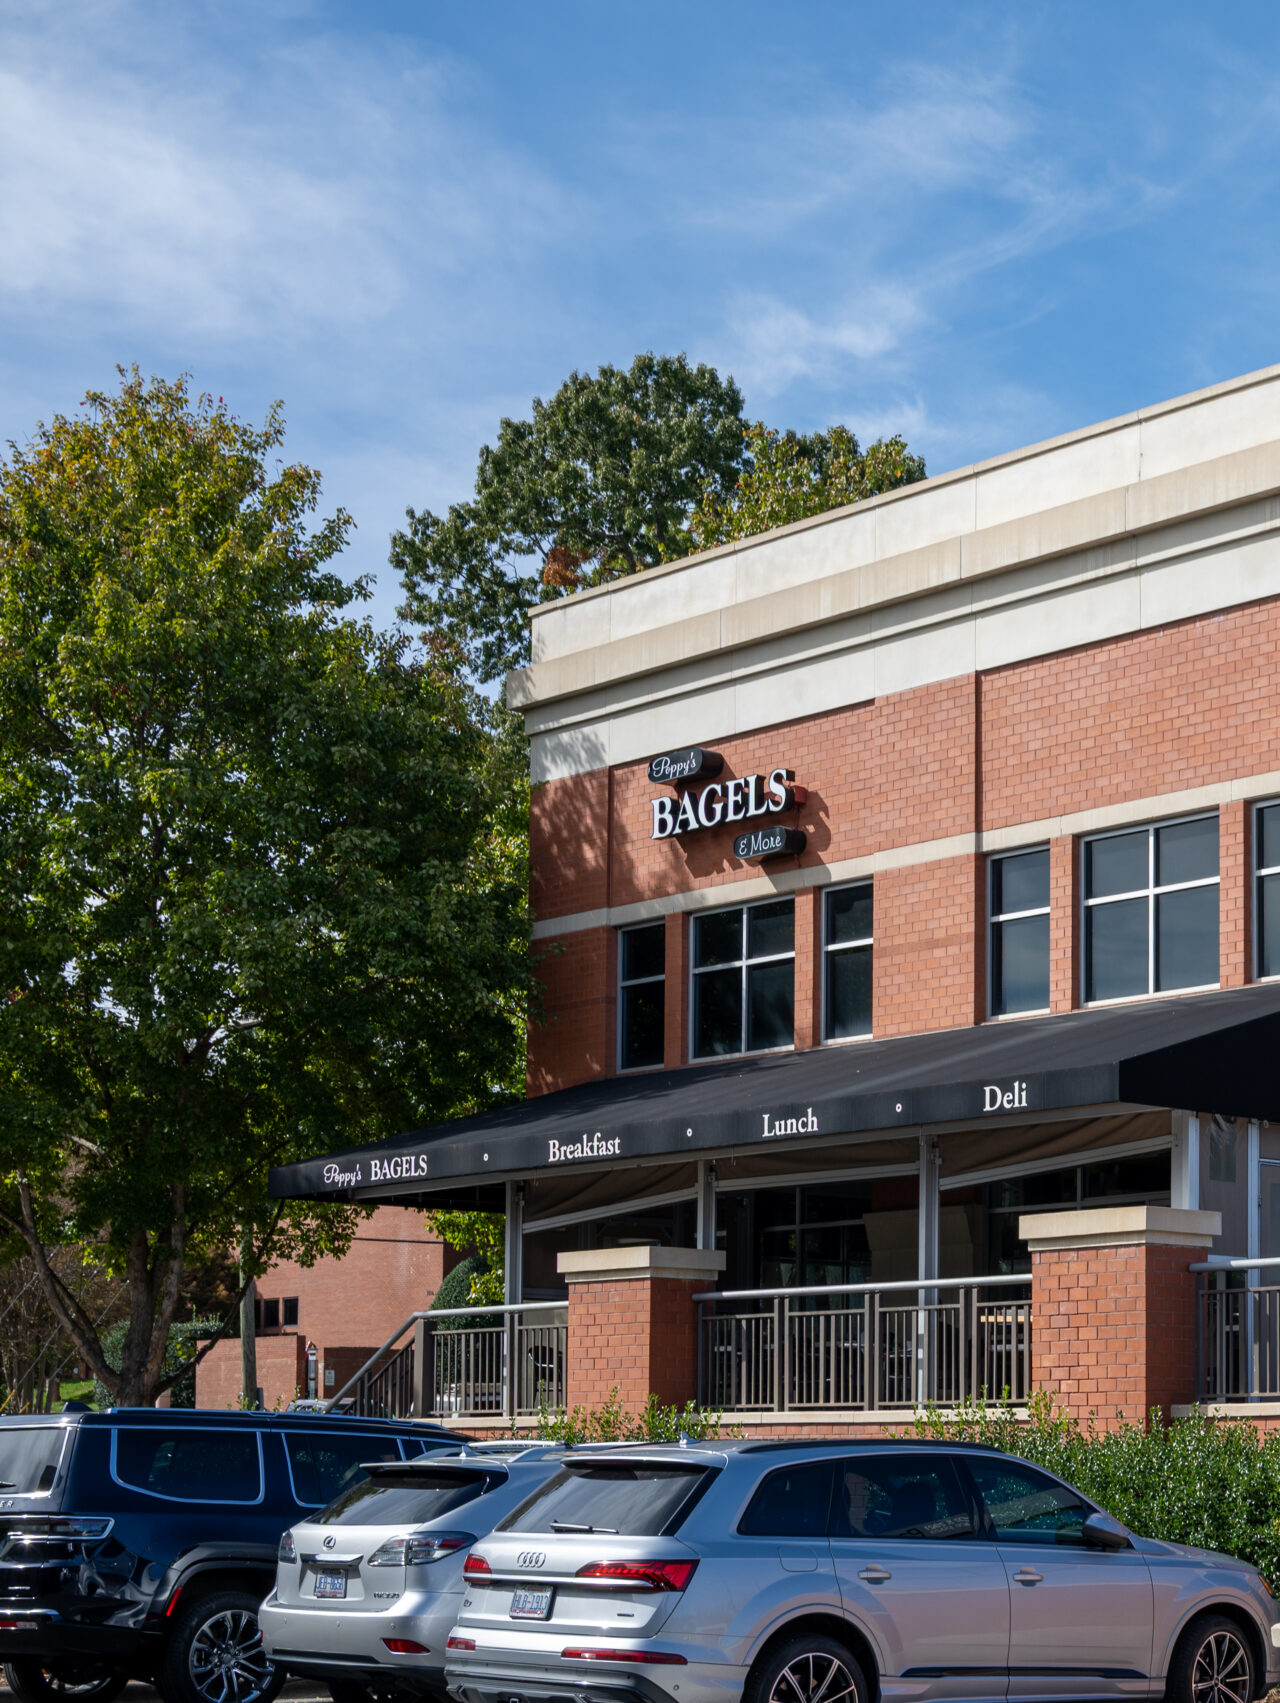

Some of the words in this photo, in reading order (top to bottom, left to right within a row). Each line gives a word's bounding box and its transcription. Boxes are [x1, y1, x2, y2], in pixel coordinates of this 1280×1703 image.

[652, 752, 696, 778] Poppy's
[651, 768, 788, 840] BAGELS
[750, 831, 783, 855] More
[983, 1080, 1028, 1112] Deli
[762, 1107, 819, 1137] Lunch
[548, 1132, 621, 1162] Breakfast
[323, 1163, 362, 1187] Poppy's
[370, 1155, 428, 1181] BAGELS
